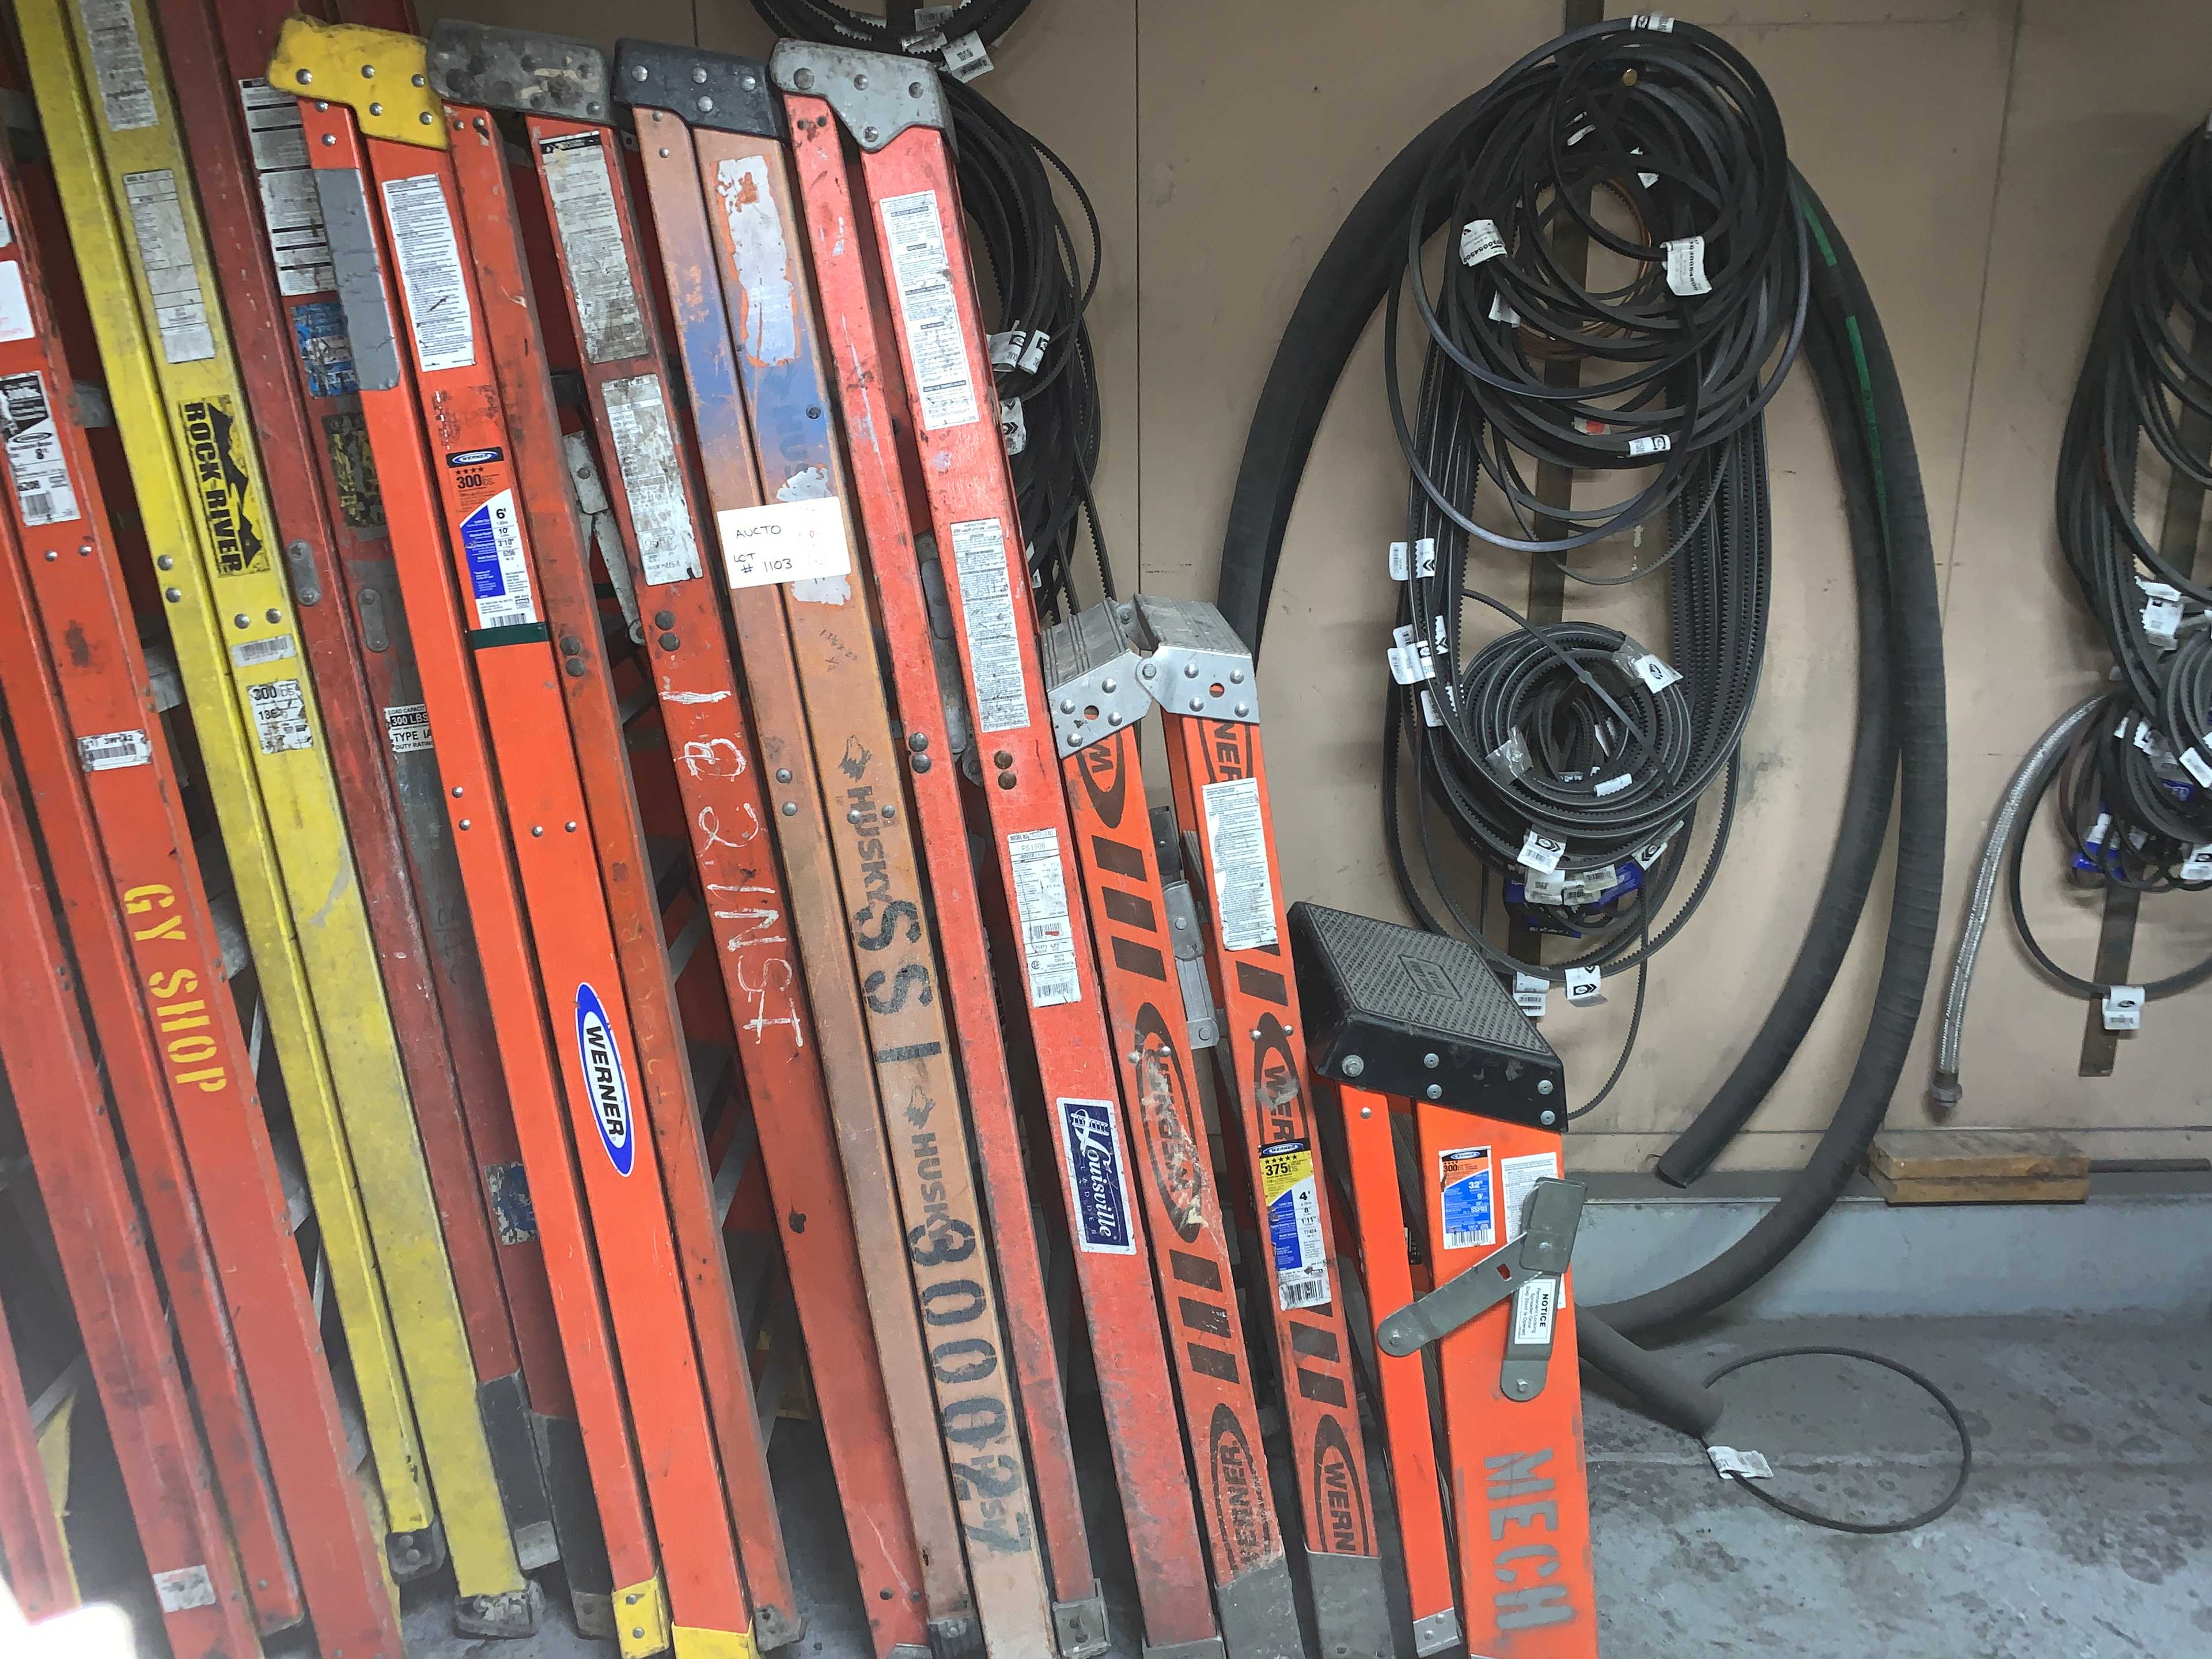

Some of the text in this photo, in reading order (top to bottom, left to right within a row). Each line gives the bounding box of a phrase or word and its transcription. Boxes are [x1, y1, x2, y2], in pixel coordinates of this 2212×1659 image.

[184, 403, 243, 574] ROCK RIVER
[456, 474, 483, 489] 300
[733, 552, 756, 563] LOT
[736, 525, 781, 539] AUCTO
[741, 558, 793, 574] # 1103
[392, 713, 429, 726] 300 LBS
[403, 705, 426, 714] CAPACIT
[393, 731, 419, 743] TYPE
[847, 786, 892, 907] HUSKY
[123, 884, 228, 1093] GY SHOP
[585, 1025, 624, 1137] WERNER
[1264, 1065, 1294, 1140] WER
[912, 1132, 954, 1244] HUSKY
[1070, 1109, 1119, 1238] Louisville
[1444, 1164, 1458, 1172] 300
[1539, 1294, 1549, 1328] NOTICE
[1324, 1461, 1357, 1551] WERN
[1484, 1447, 1576, 1630] MECH
